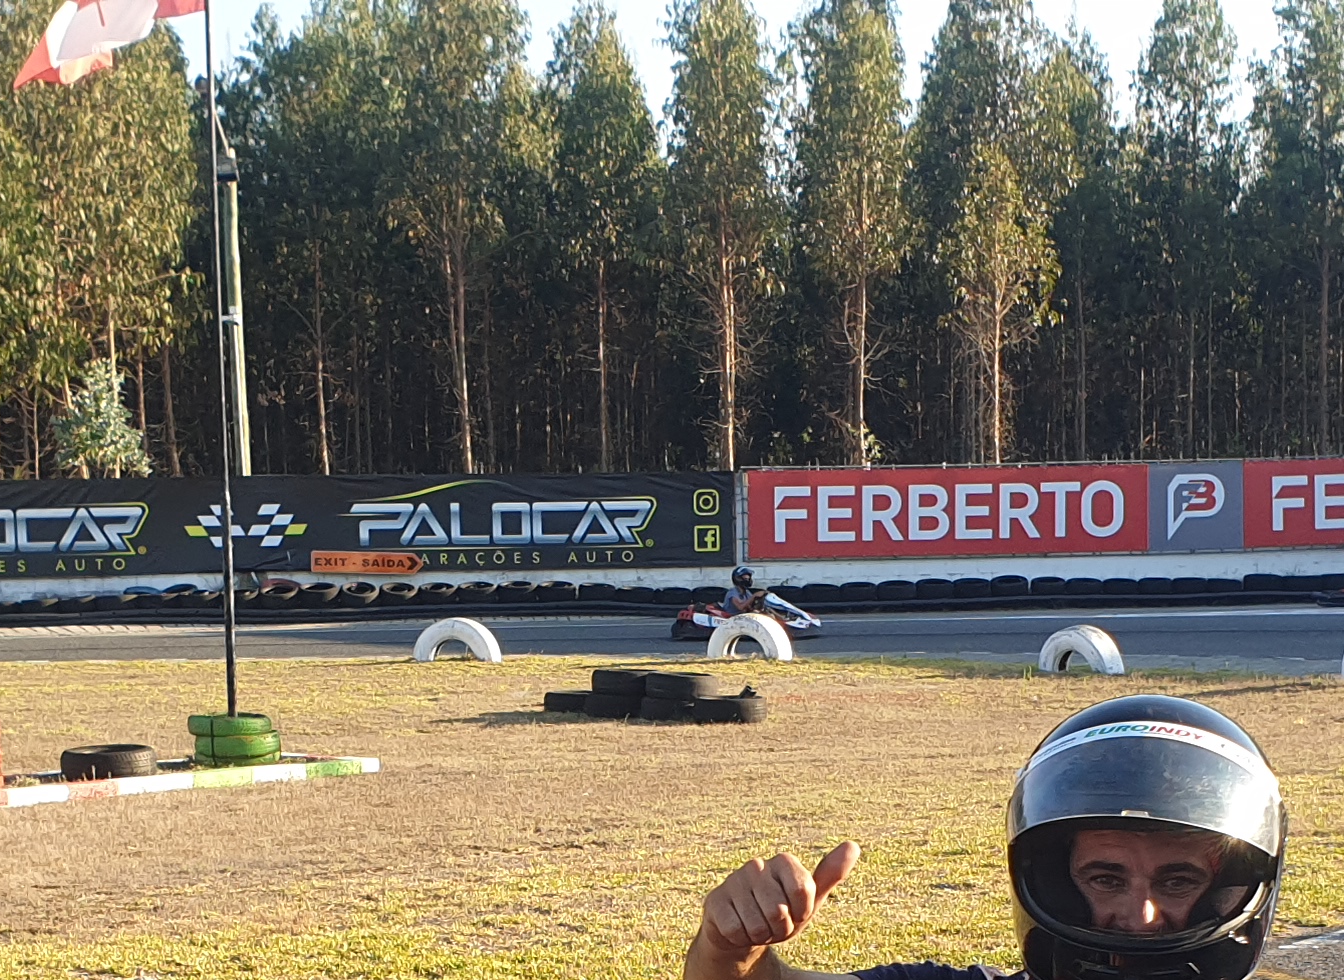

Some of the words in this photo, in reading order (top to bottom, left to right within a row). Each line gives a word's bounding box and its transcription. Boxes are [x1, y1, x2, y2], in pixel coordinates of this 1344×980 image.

[774, 479, 1125, 544] FERBERTO
[349, 502, 653, 547] PALOCAR
[56, 557, 127, 572] AUTO
[314, 556, 347, 569] EXIT
[361, 554, 406, 570] SAÍDA
[420, 550, 541, 567] ARAÇÕES
[568, 550, 635, 564] AUTO
[1084, 724, 1206, 741] EUROINDY
